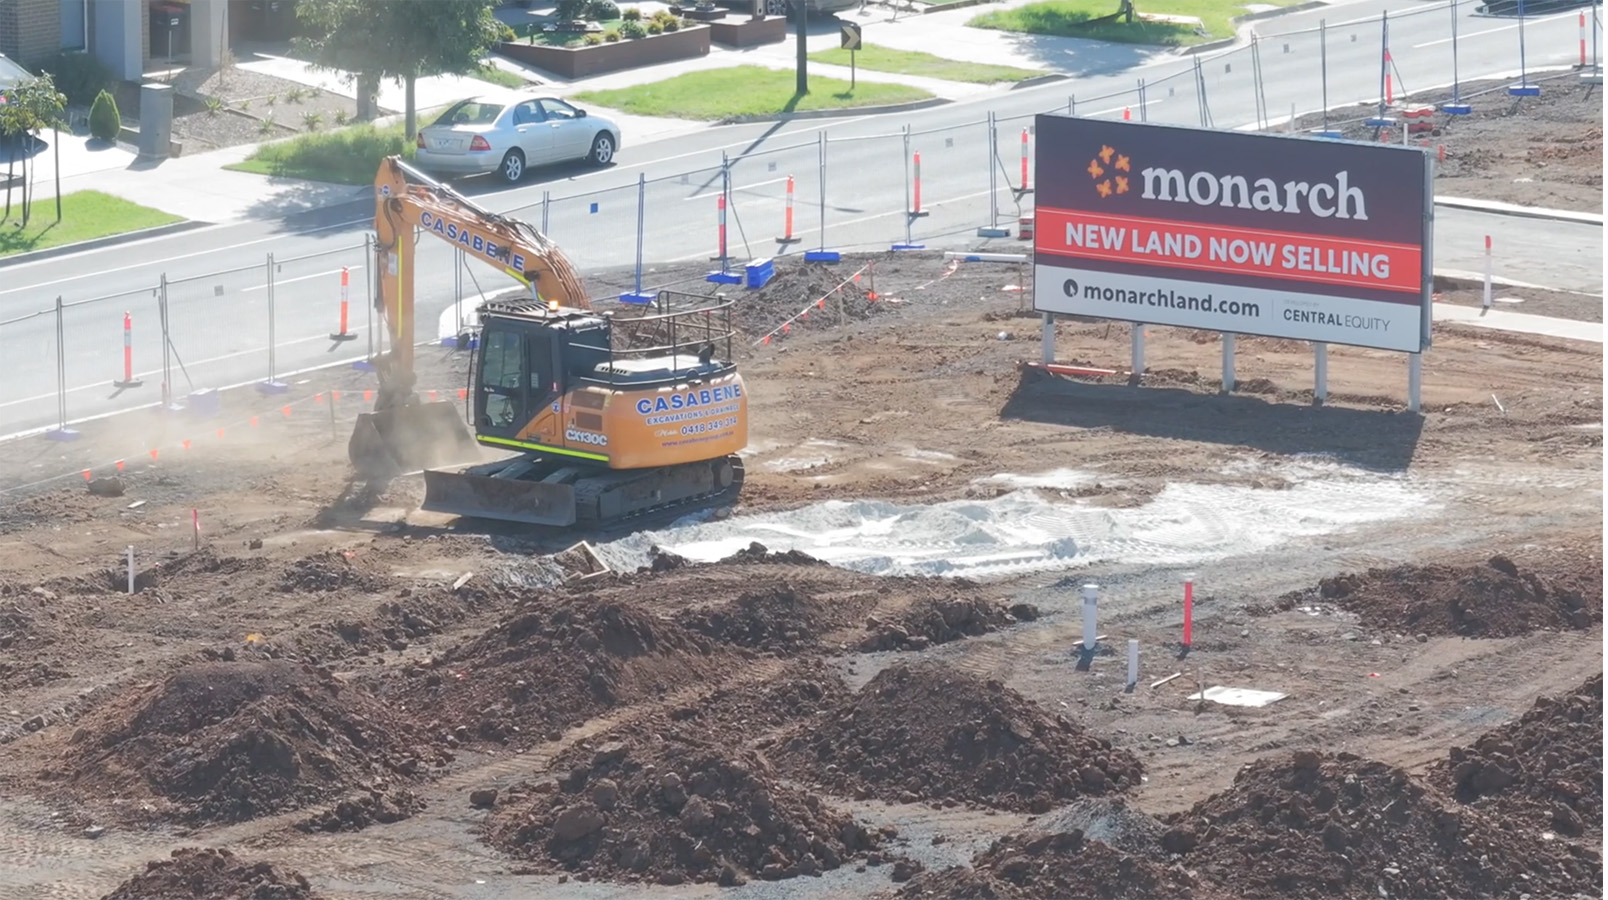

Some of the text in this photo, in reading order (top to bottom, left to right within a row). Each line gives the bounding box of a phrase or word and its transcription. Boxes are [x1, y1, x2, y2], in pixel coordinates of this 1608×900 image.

[1141, 167, 1369, 221] monarch
[1065, 222, 1390, 279] NEW LAND NOW SELLING
[1084, 282, 1260, 318] monarchland.com
[1283, 308, 1391, 332] CENTRAL EQUITY
[636, 384, 741, 414] CASABENE
[646, 410, 703, 425] EXCAVATIONS
[680, 422, 706, 436] 0418
[707, 418, 724, 431] 349
[725, 415, 738, 427] 314
[565, 429, 608, 446] CX130C
